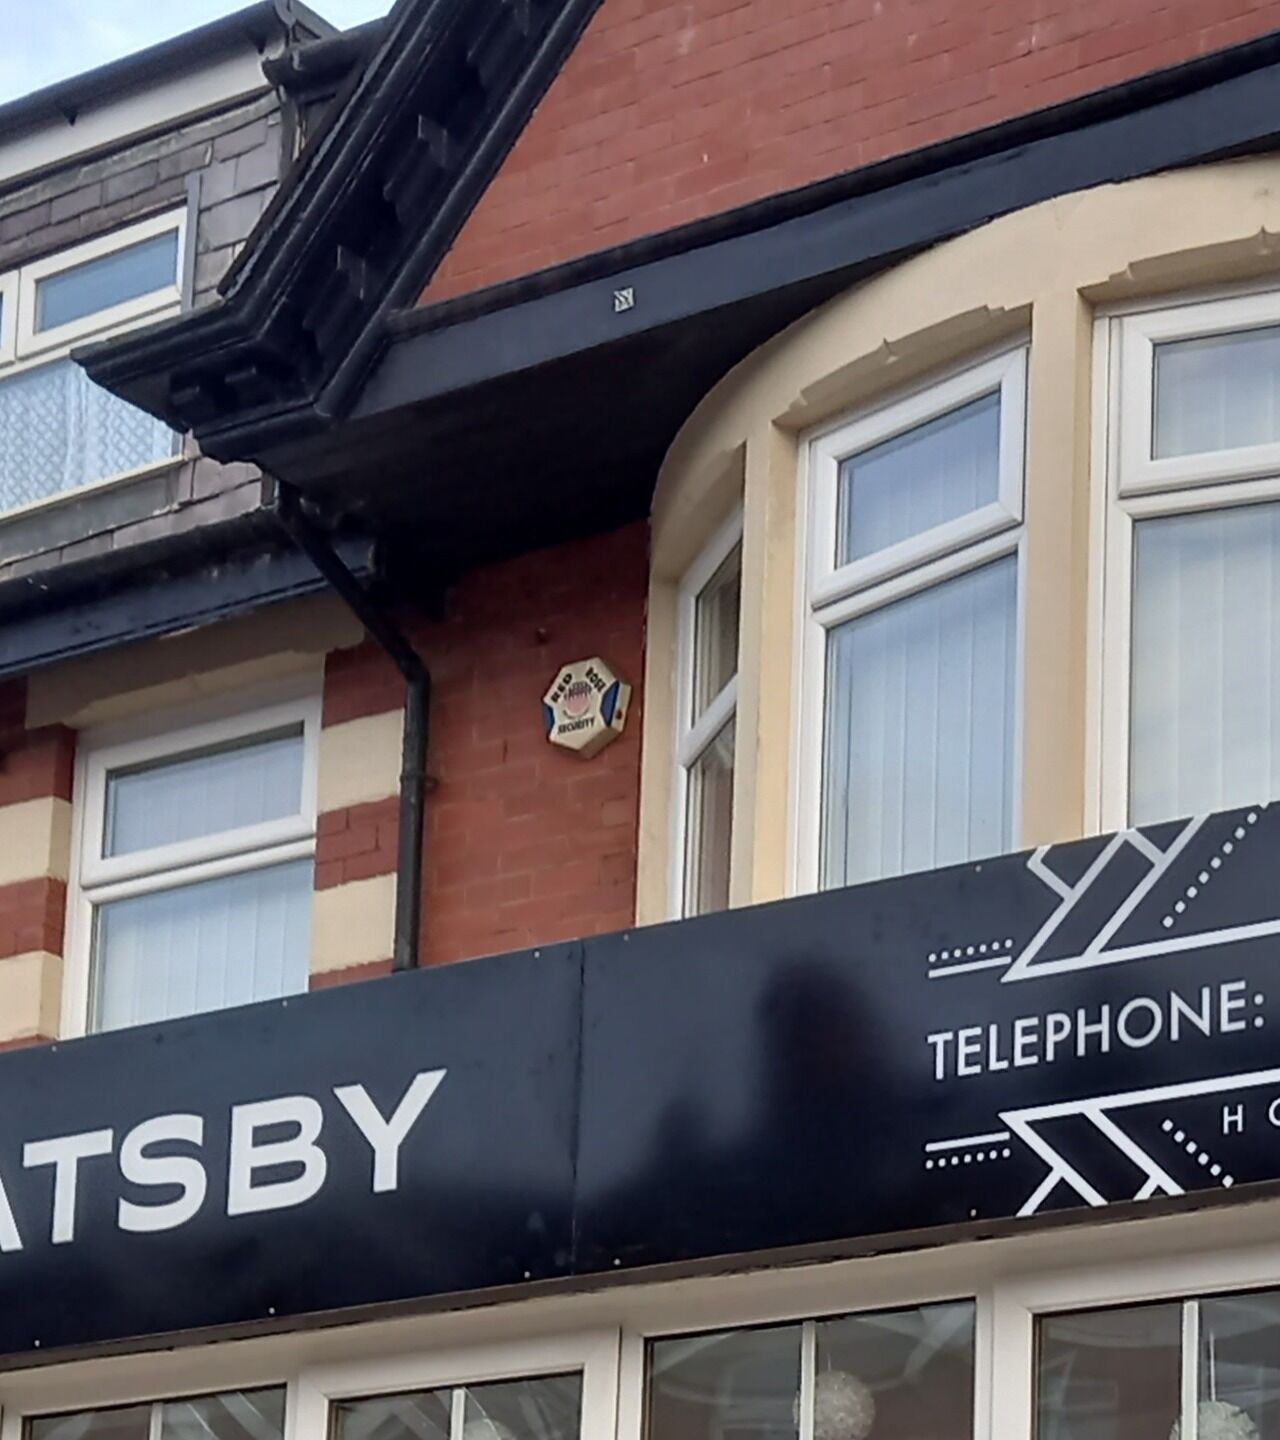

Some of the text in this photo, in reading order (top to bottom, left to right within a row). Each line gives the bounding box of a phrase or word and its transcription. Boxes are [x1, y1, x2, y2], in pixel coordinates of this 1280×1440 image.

[551, 673, 573, 703] RED
[558, 717, 595, 734] SECURITY
[928, 980, 1265, 1080] TELEPHONE:
